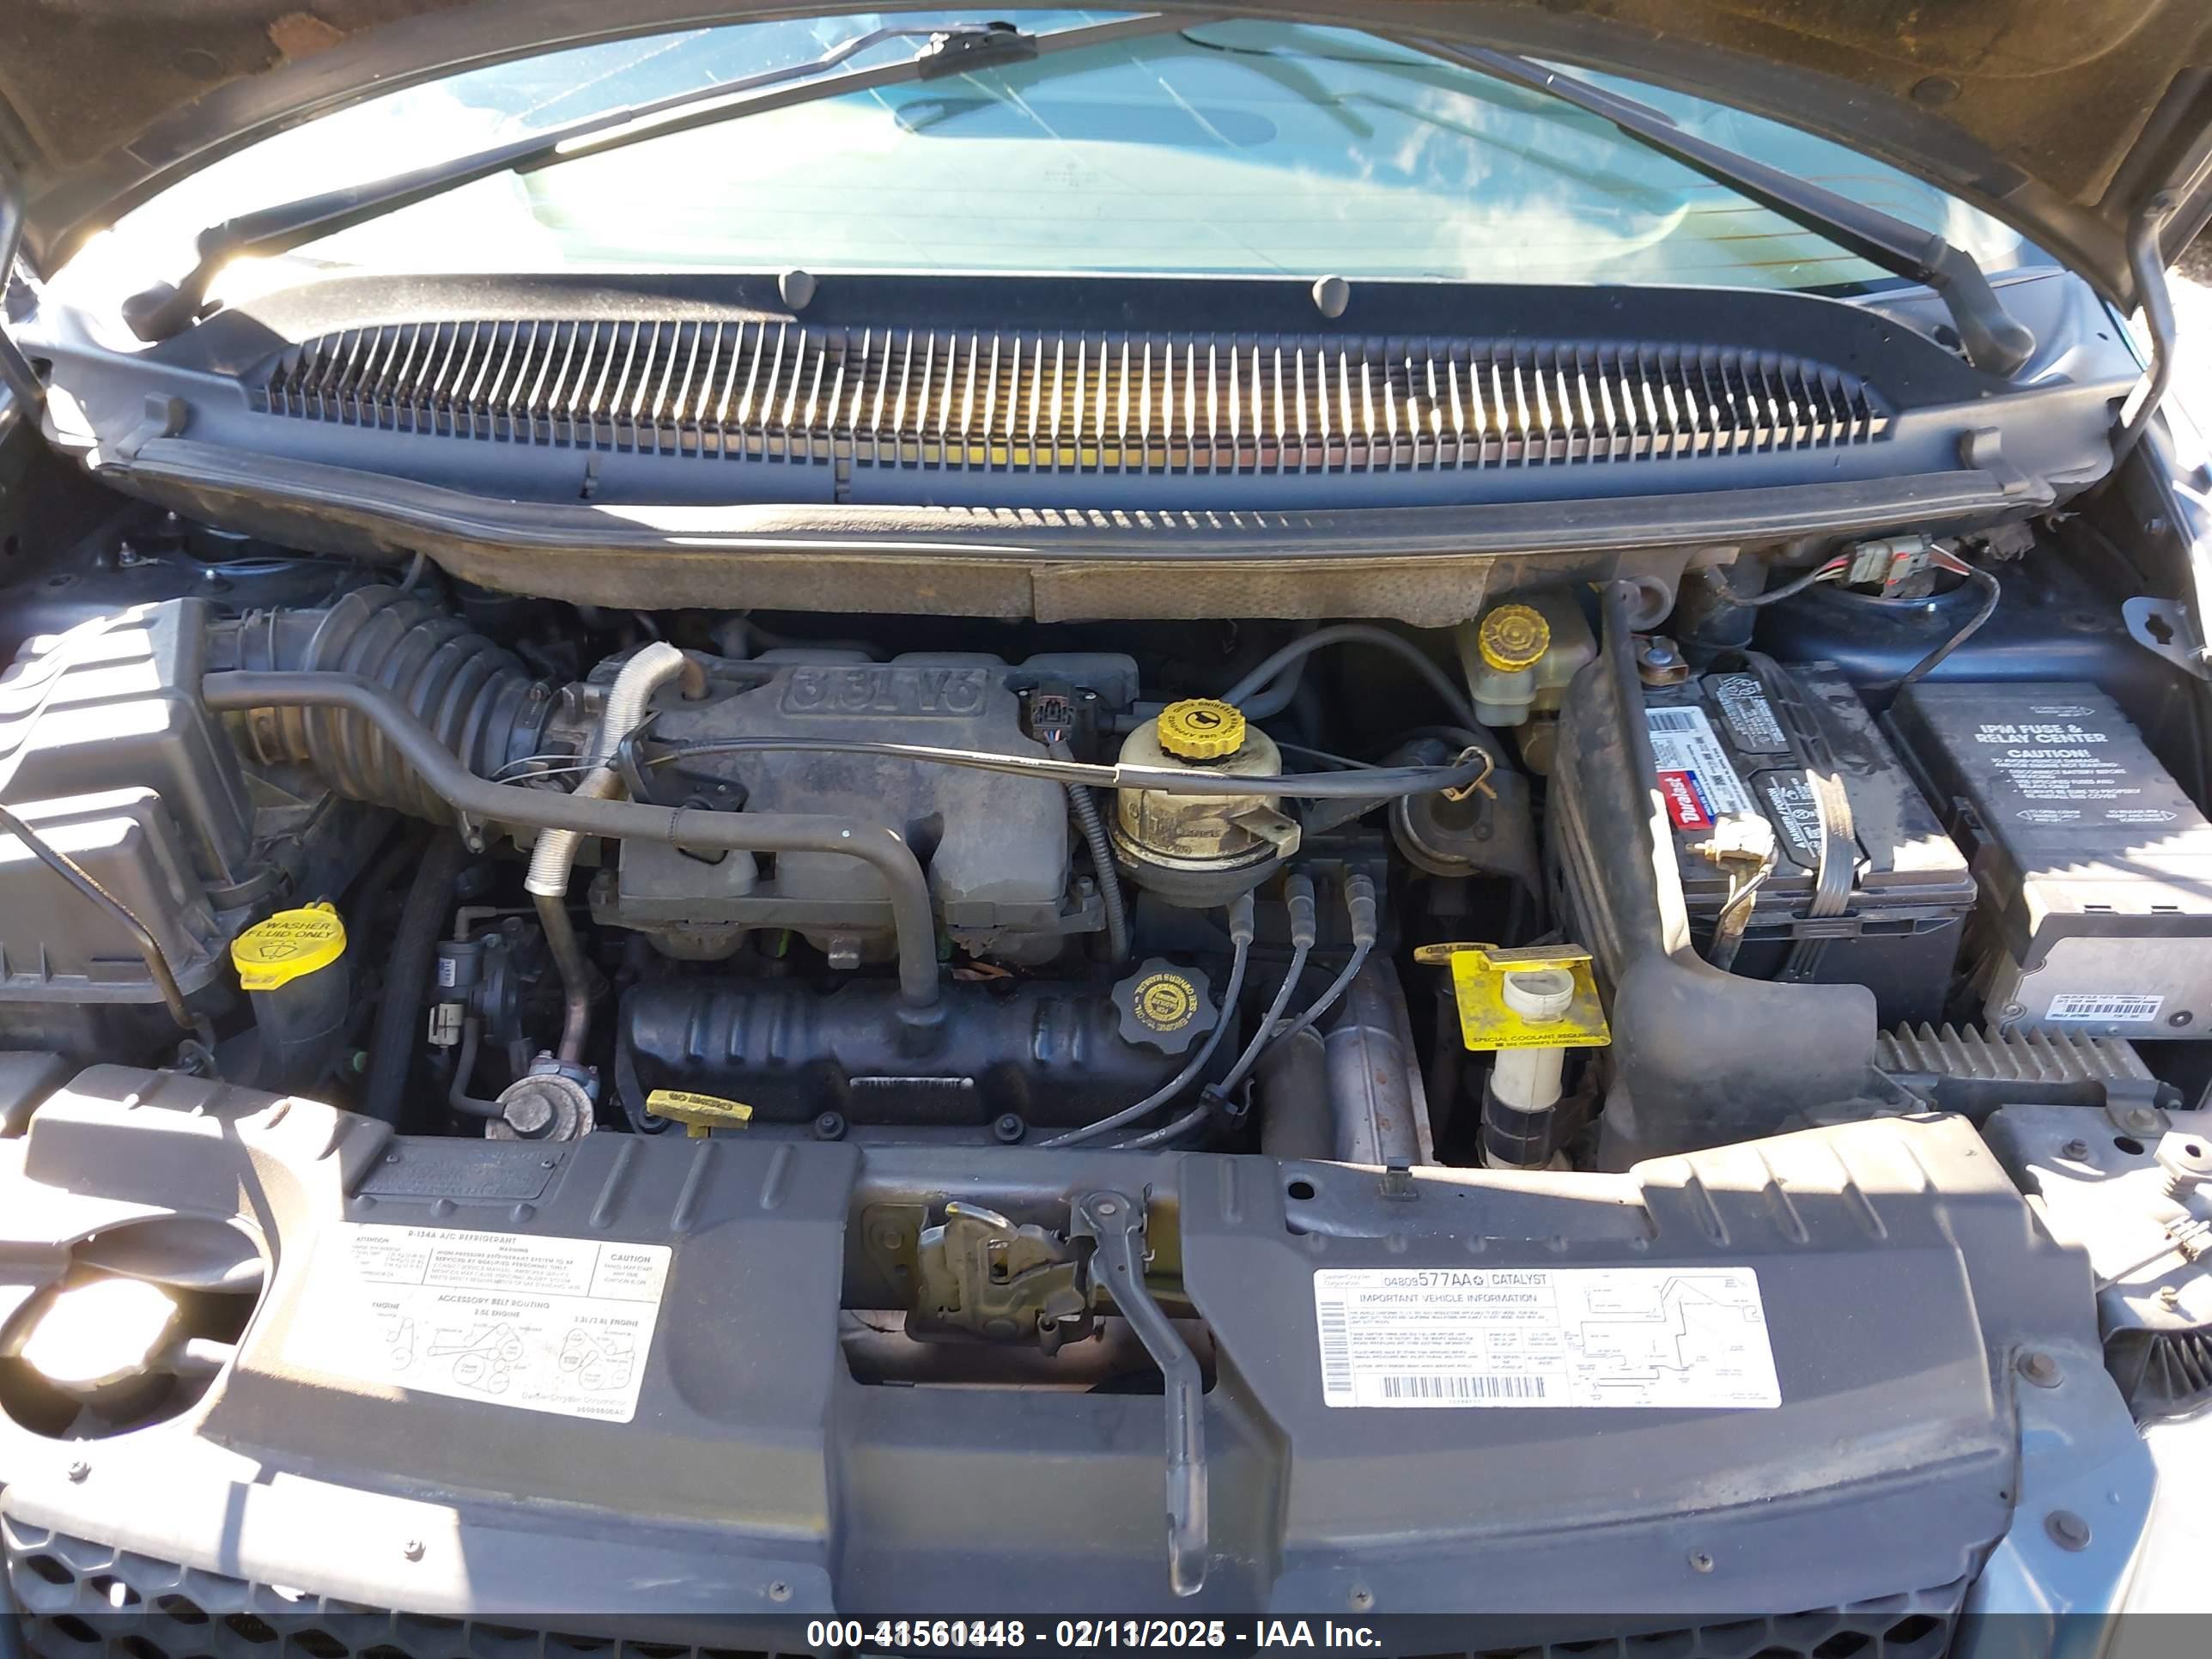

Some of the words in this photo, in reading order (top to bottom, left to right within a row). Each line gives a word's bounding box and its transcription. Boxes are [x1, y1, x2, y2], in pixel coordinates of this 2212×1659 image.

[1979, 725, 2016, 733] IPM
[2019, 725, 2064, 733] FUSE
[2067, 724, 2084, 733] &
[1974, 733, 2030, 743] RELAY
[2035, 733, 2109, 743] CENTER
[2007, 749, 2091, 758] CAUTION!
[1664, 777, 1701, 823] Duralast
[265, 921, 331, 930] WASHER
[459, 1234, 517, 1244] REFRIGERANT
[611, 1254, 651, 1263] CAUTION
[1492, 1273, 1547, 1285] CATALYST
[438, 1295, 489, 1305] ACCESSORY
[491, 1297, 510, 1306] BELT
[512, 1299, 550, 1310] ROUTING
[1359, 1294, 1419, 1303] IMPORTANT
[1422, 1294, 1464, 1303] VEHICLE
[1467, 1294, 1538, 1303] INFORMATION
[610, 1318, 639, 1327] ENGINE
